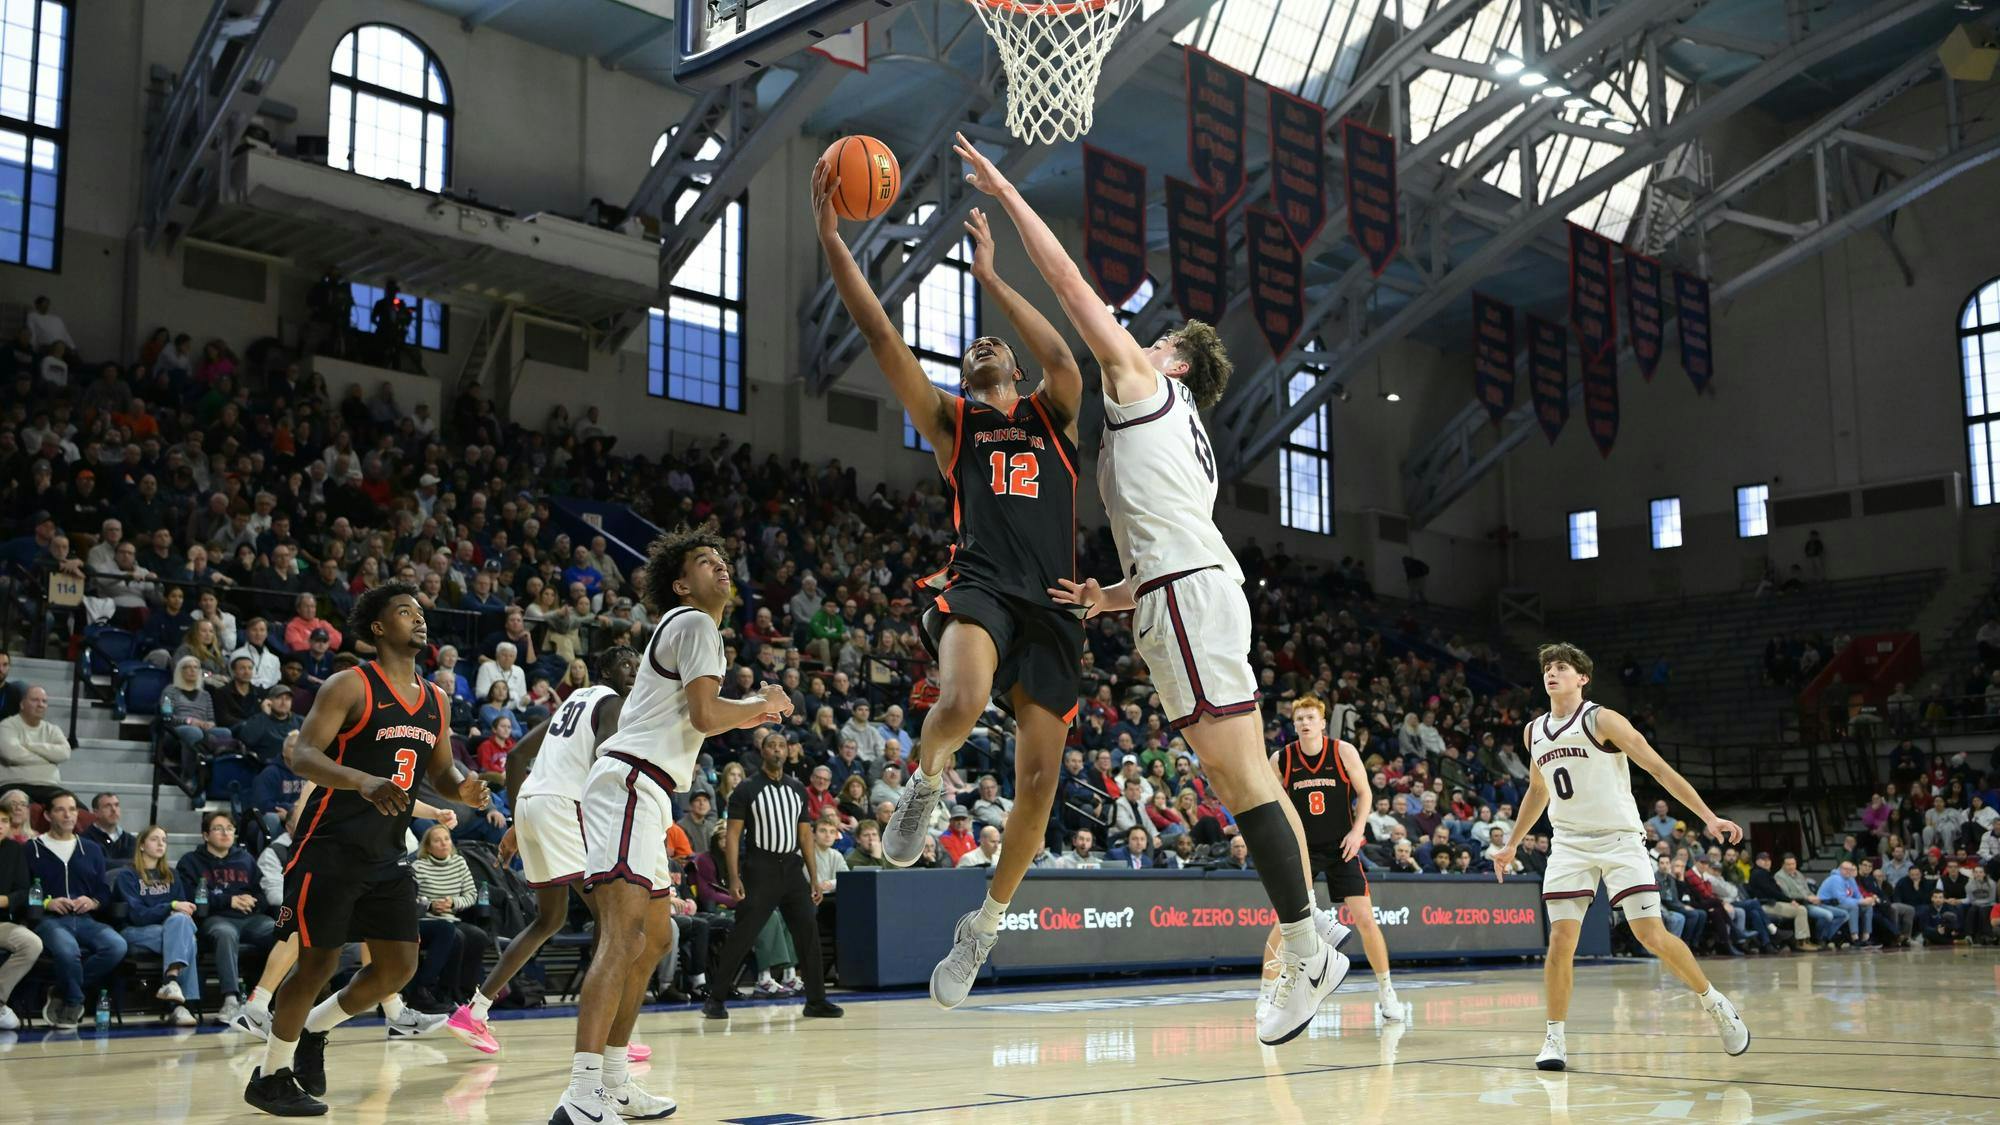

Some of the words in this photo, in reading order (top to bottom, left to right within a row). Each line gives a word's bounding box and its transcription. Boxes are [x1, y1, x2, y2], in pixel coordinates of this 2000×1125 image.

[989, 450, 1040, 498] 12
[57, 583, 76, 594] 114
[548, 701, 587, 738] 30
[391, 748, 418, 791] 3
[1553, 766, 1575, 801] 0
[1308, 791, 1326, 815] 8
[275, 906, 293, 928] P
[1039, 906, 1084, 930] Coke
[1084, 906, 1134, 929] Ever?
[1150, 905, 1188, 928] Coke
[1191, 908, 1234, 927] ZERO
[1237, 907, 1278, 926] SUGA
[1372, 906, 1410, 925] Ever?
[1422, 905, 1453, 925] Coke
[1455, 908, 1490, 925] ZERO
[1492, 908, 1536, 925] SUGAR
